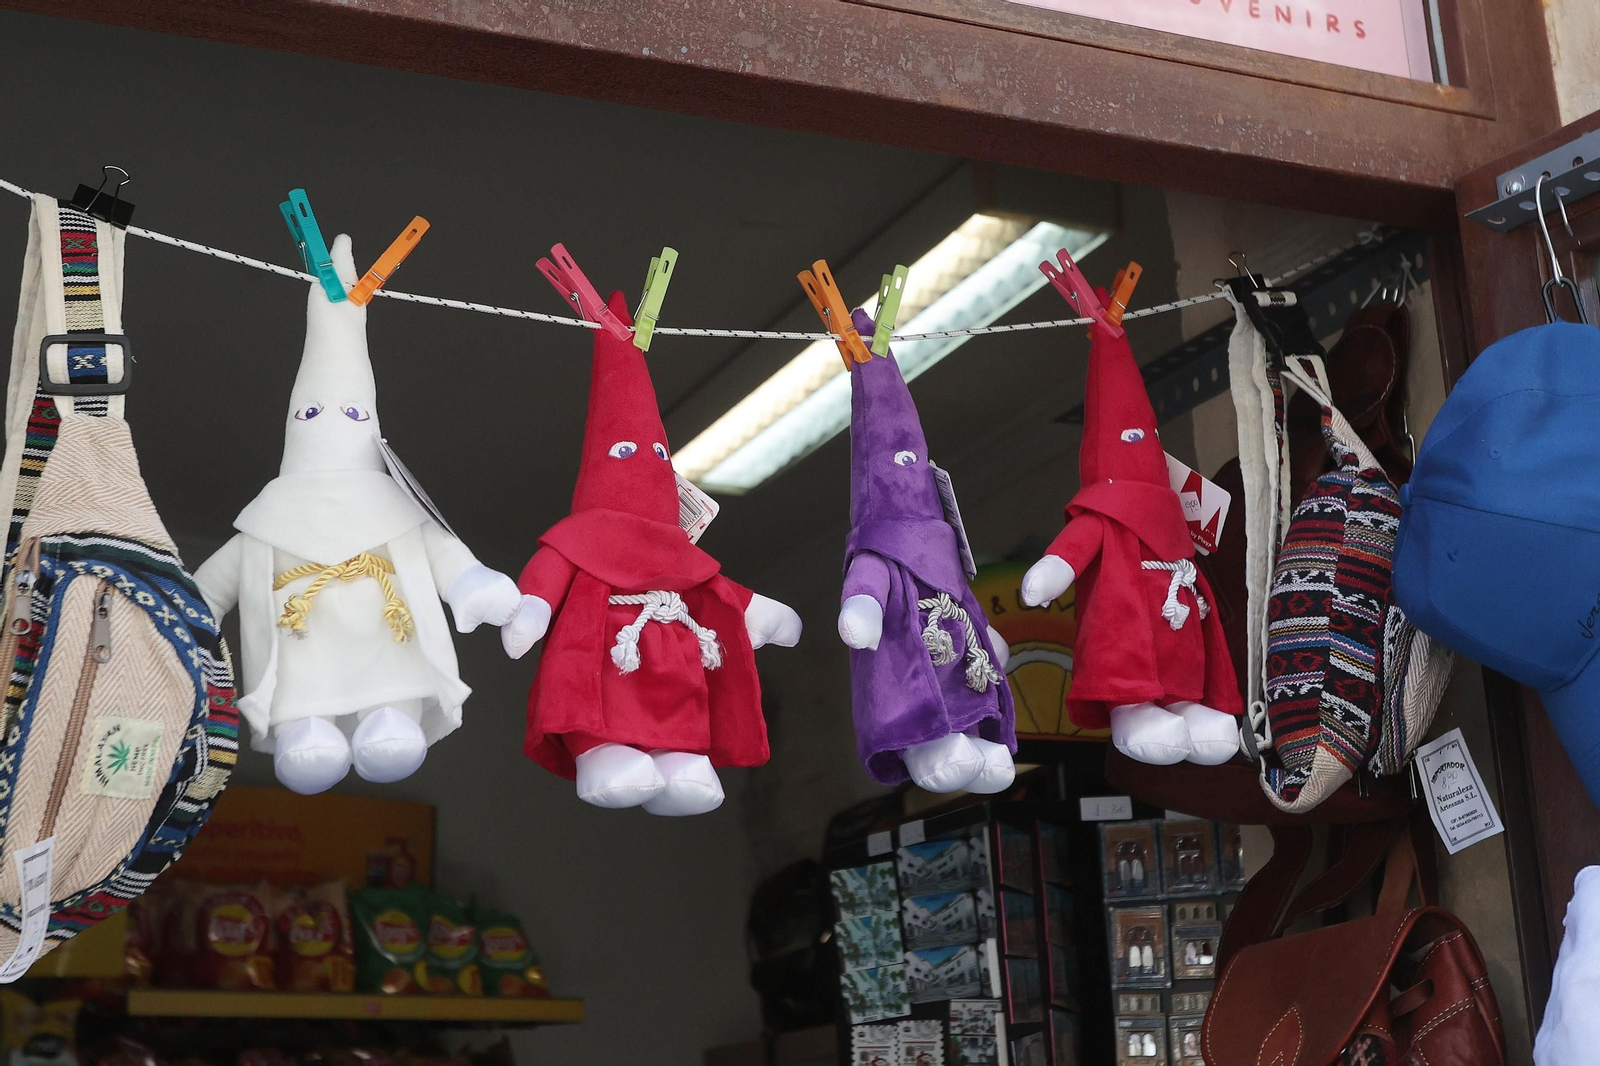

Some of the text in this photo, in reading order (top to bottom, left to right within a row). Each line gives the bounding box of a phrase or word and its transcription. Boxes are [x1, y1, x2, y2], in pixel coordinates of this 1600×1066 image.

[1189, 0, 1367, 39] VENIRS
[1431, 761, 1466, 784] IMPORTADOR
[1437, 783, 1474, 805] Naturaleza
[1439, 798, 1465, 814] Artesana
